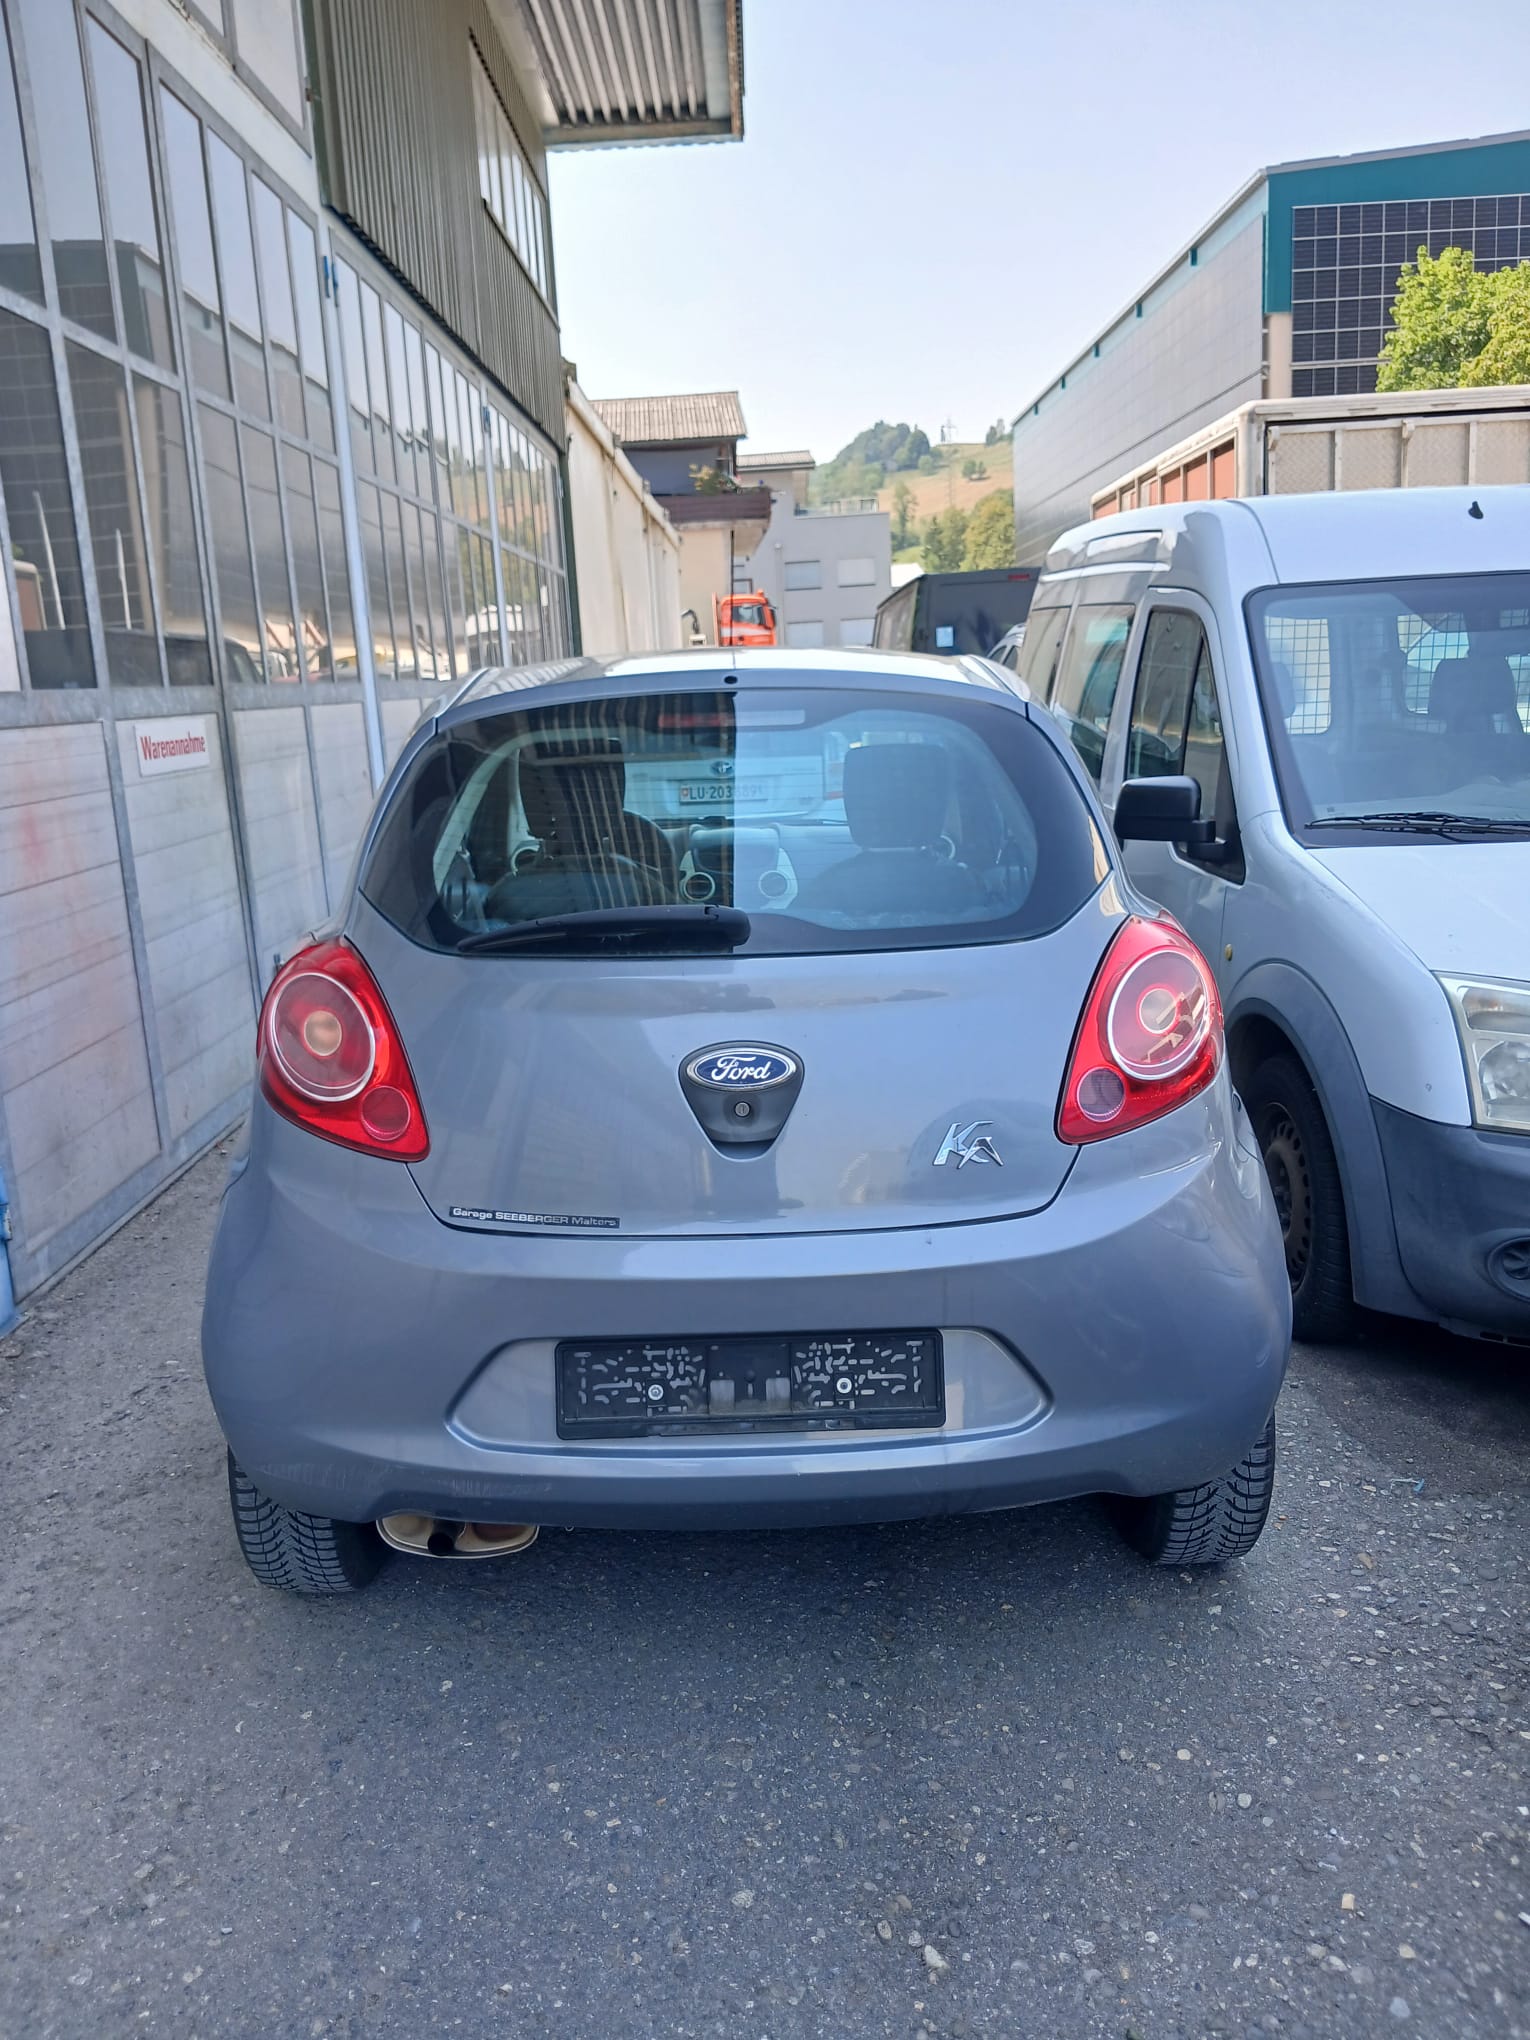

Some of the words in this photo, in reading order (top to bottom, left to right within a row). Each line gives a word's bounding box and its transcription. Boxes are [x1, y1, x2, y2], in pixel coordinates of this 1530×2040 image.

[140, 731, 206, 760] Warenannahme
[711, 1057, 771, 1080] Ford
[453, 1207, 493, 1220] Garage
[495, 1211, 570, 1225] SEEBERGER
